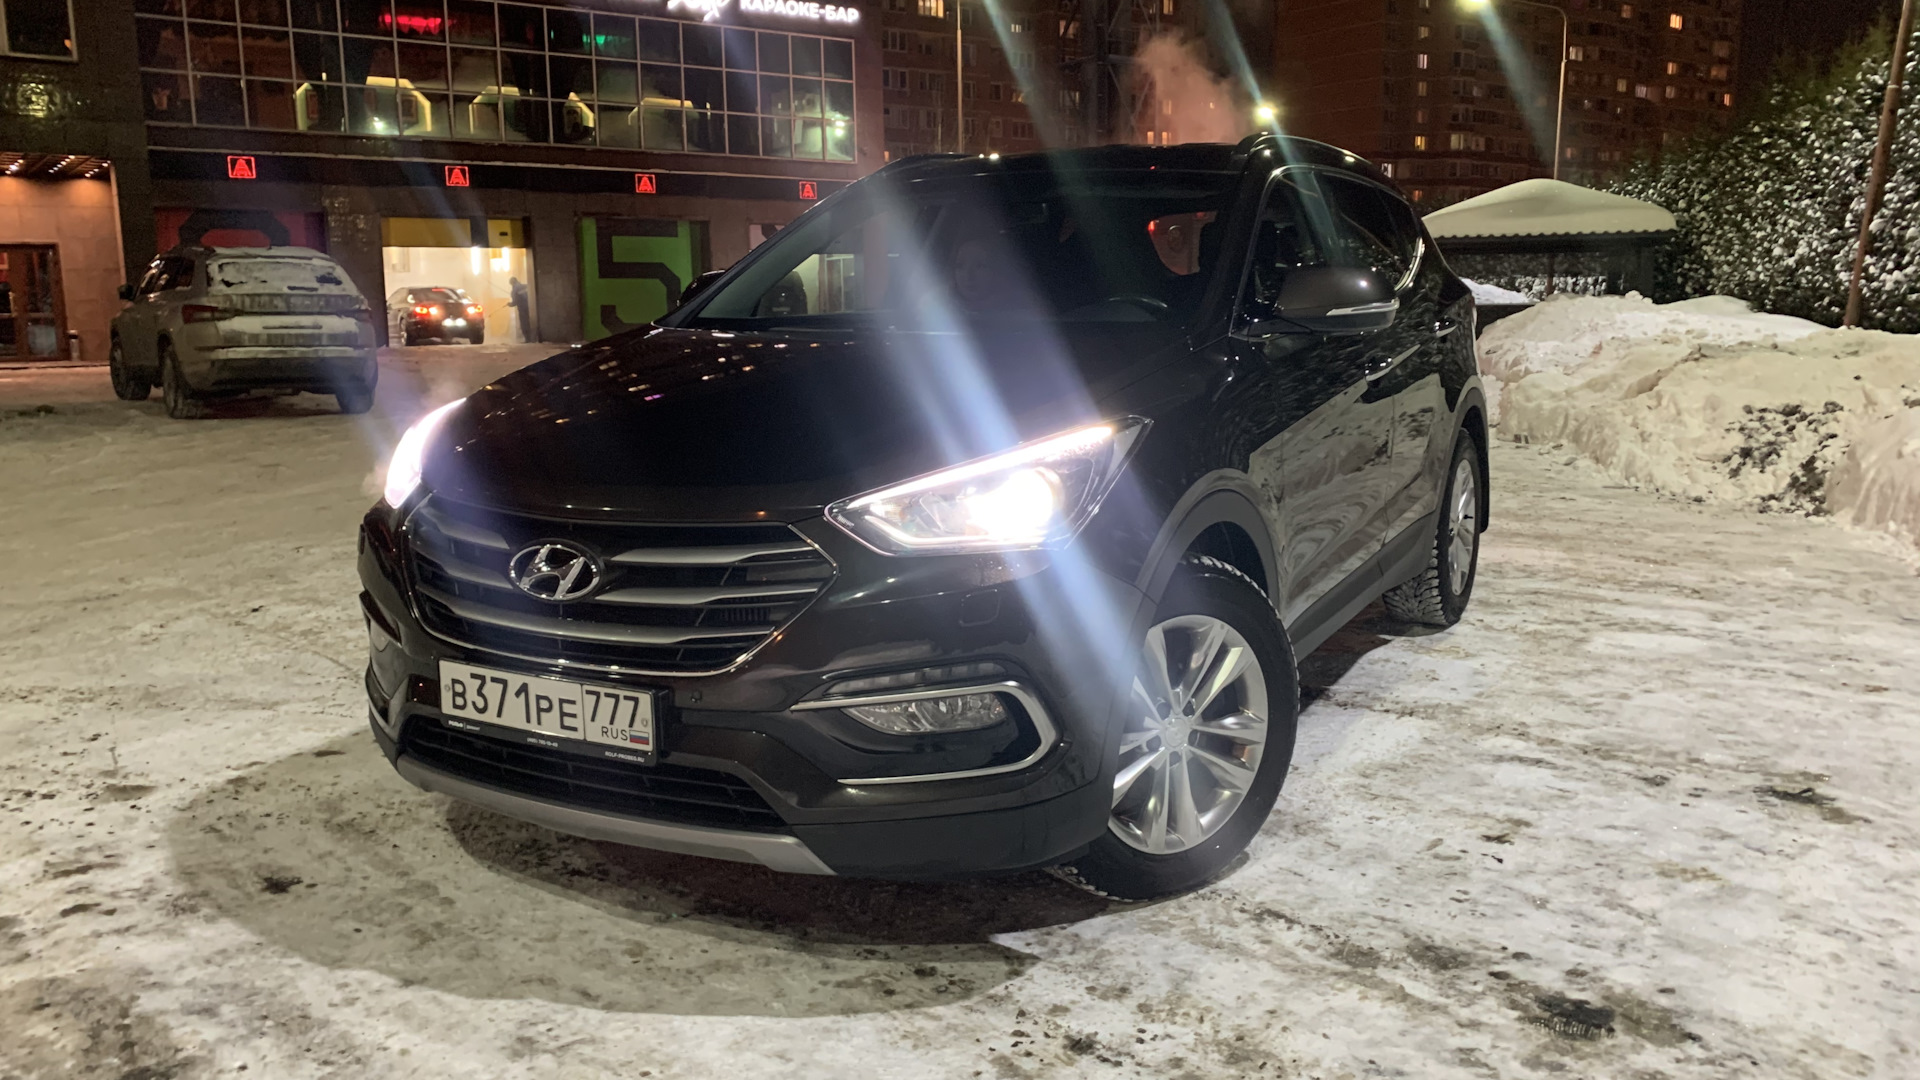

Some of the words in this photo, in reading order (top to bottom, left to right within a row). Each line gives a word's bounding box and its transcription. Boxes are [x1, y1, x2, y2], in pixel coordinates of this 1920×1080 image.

[739, 0, 860, 23] КАРАОКЕ-БАР
[596, 218, 681, 336] 5
[585, 690, 640, 728] 777
[601, 726, 629, 741] RUS
